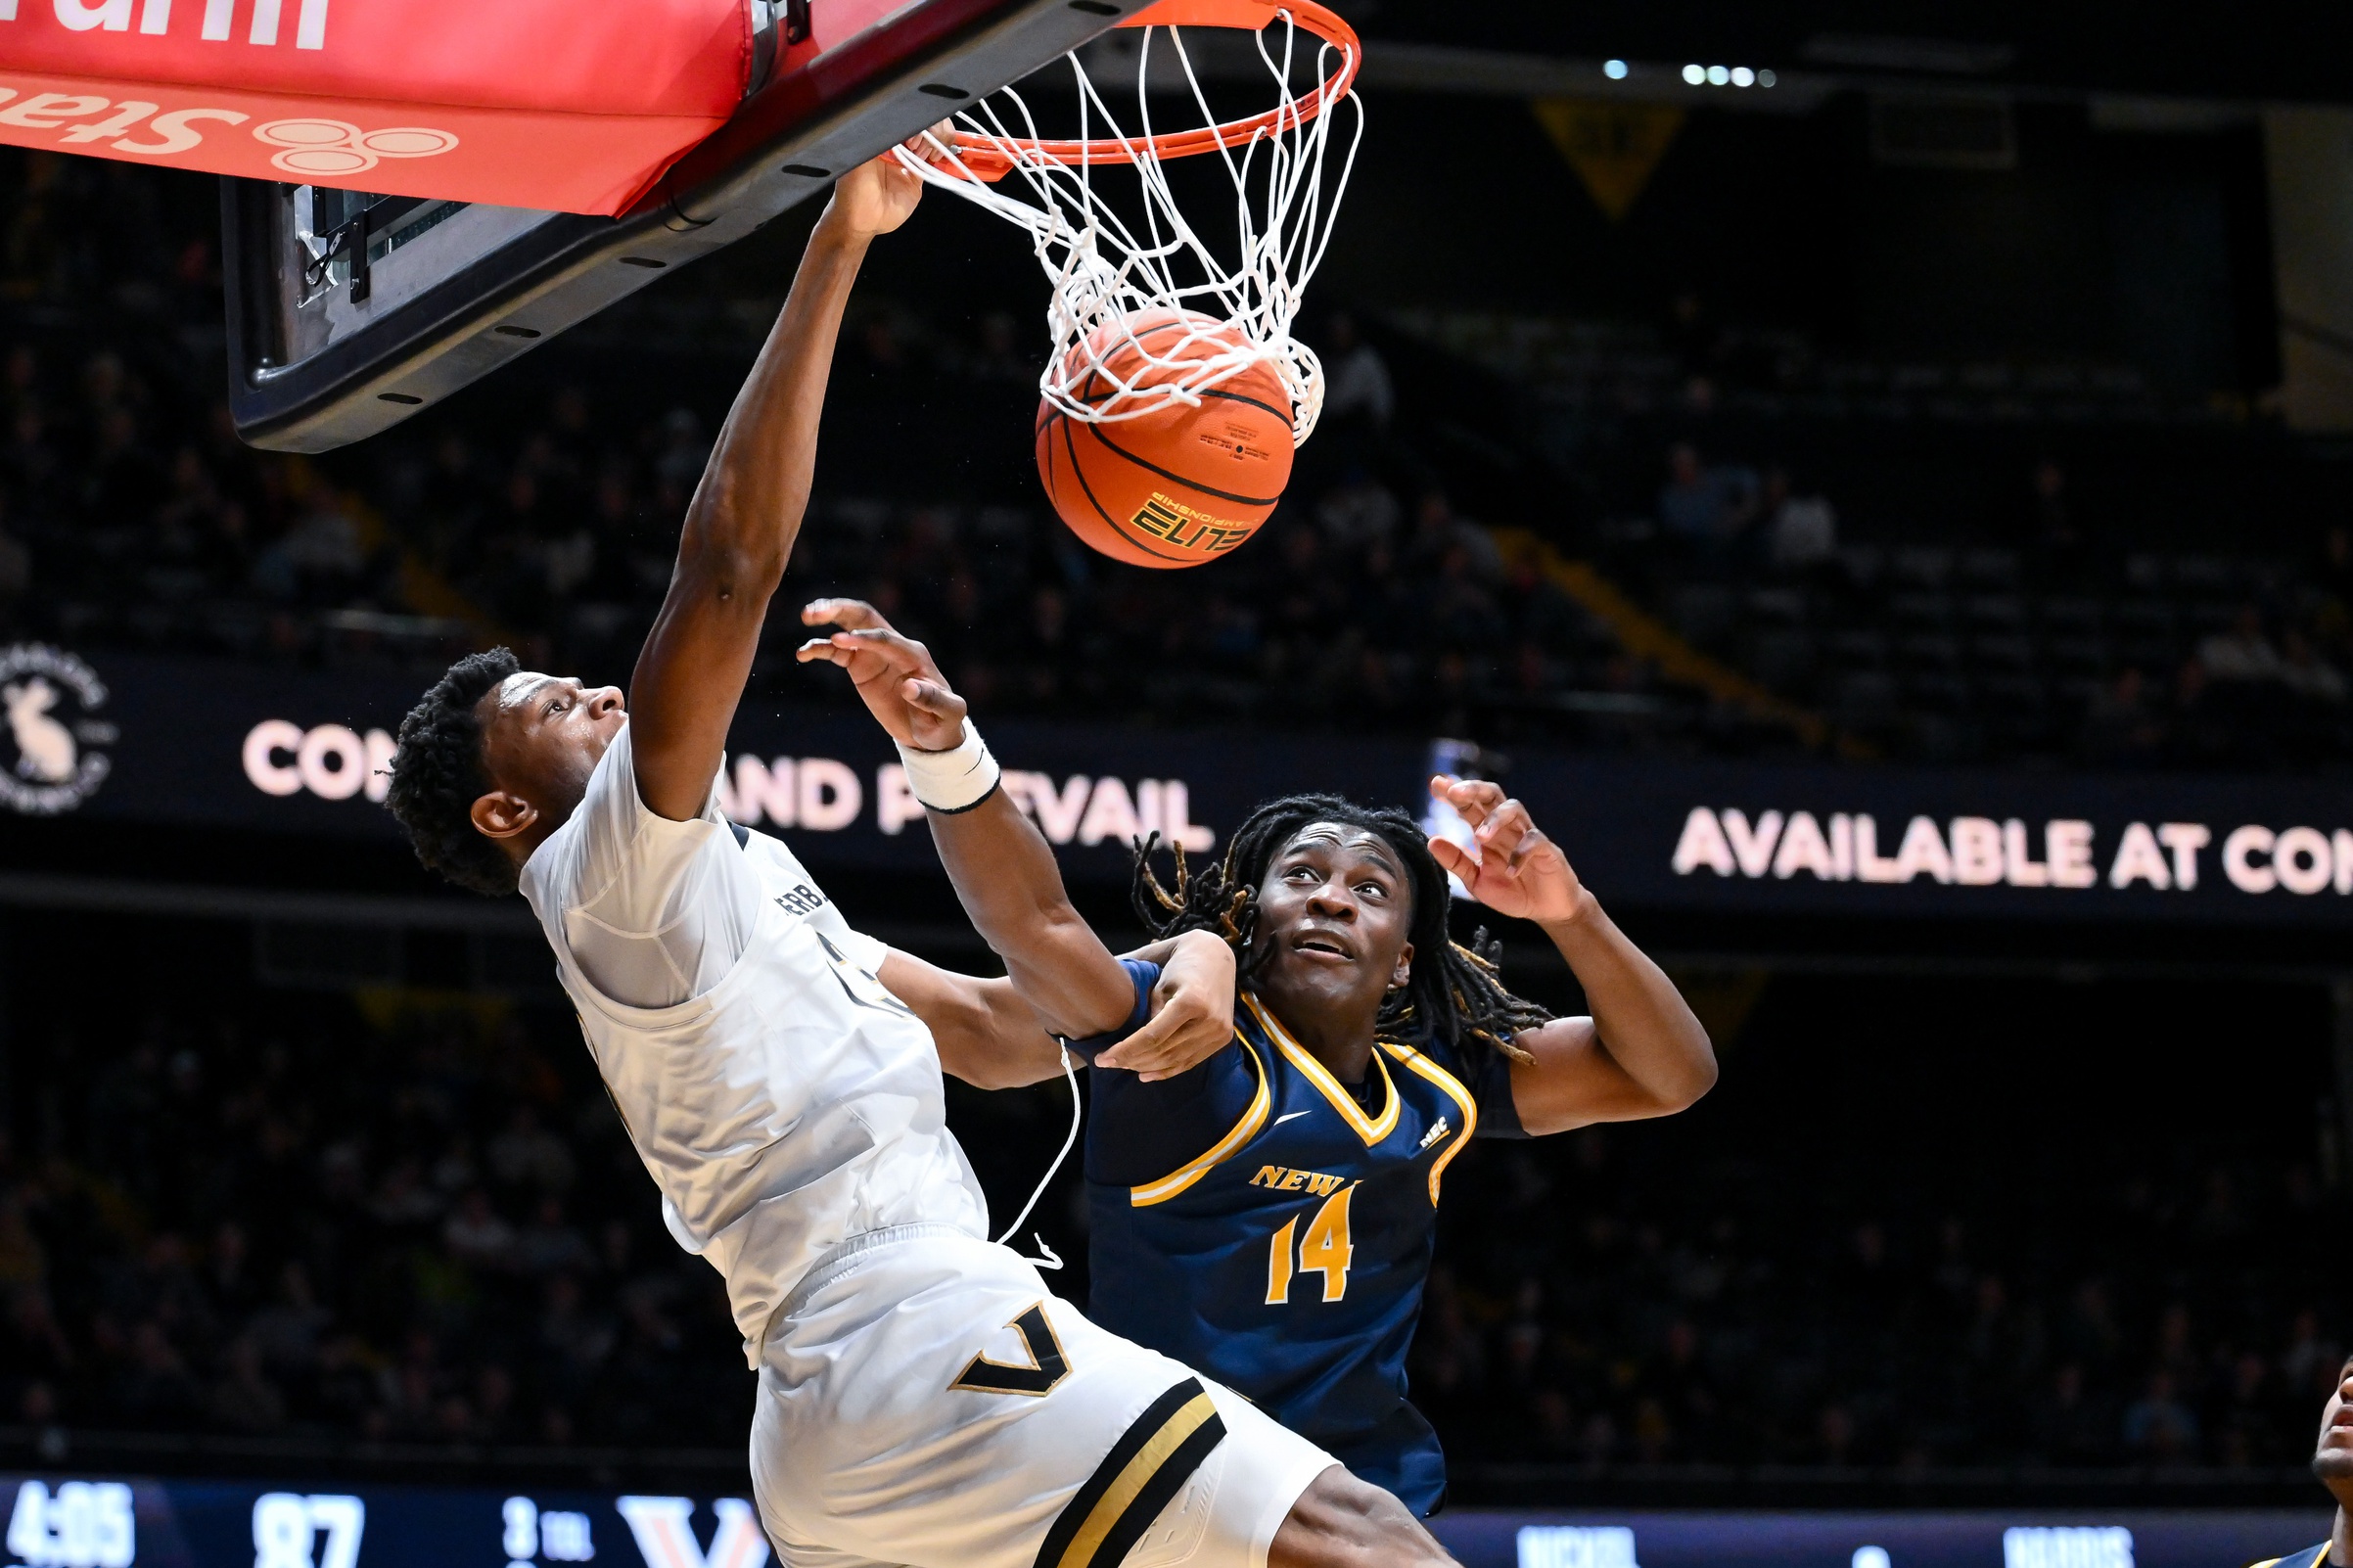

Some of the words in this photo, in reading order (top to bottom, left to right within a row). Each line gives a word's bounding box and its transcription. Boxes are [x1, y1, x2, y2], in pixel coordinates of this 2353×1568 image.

[0, 86, 252, 156] Sta
[1129, 497, 1253, 552] ELITE
[1151, 490, 1259, 528] AMPIONSHIP
[877, 762, 1217, 853] PVAIL
[1672, 807, 2097, 889] AVAILABLE
[2110, 821, 2212, 892] AT
[773, 884, 829, 917] ERB
[1419, 1116, 1448, 1149] NEC
[1248, 1165, 1345, 1198] NEW
[1265, 1183, 1355, 1306] 14
[946, 1299, 1075, 1398] V
[252, 1492, 365, 1568] 87
